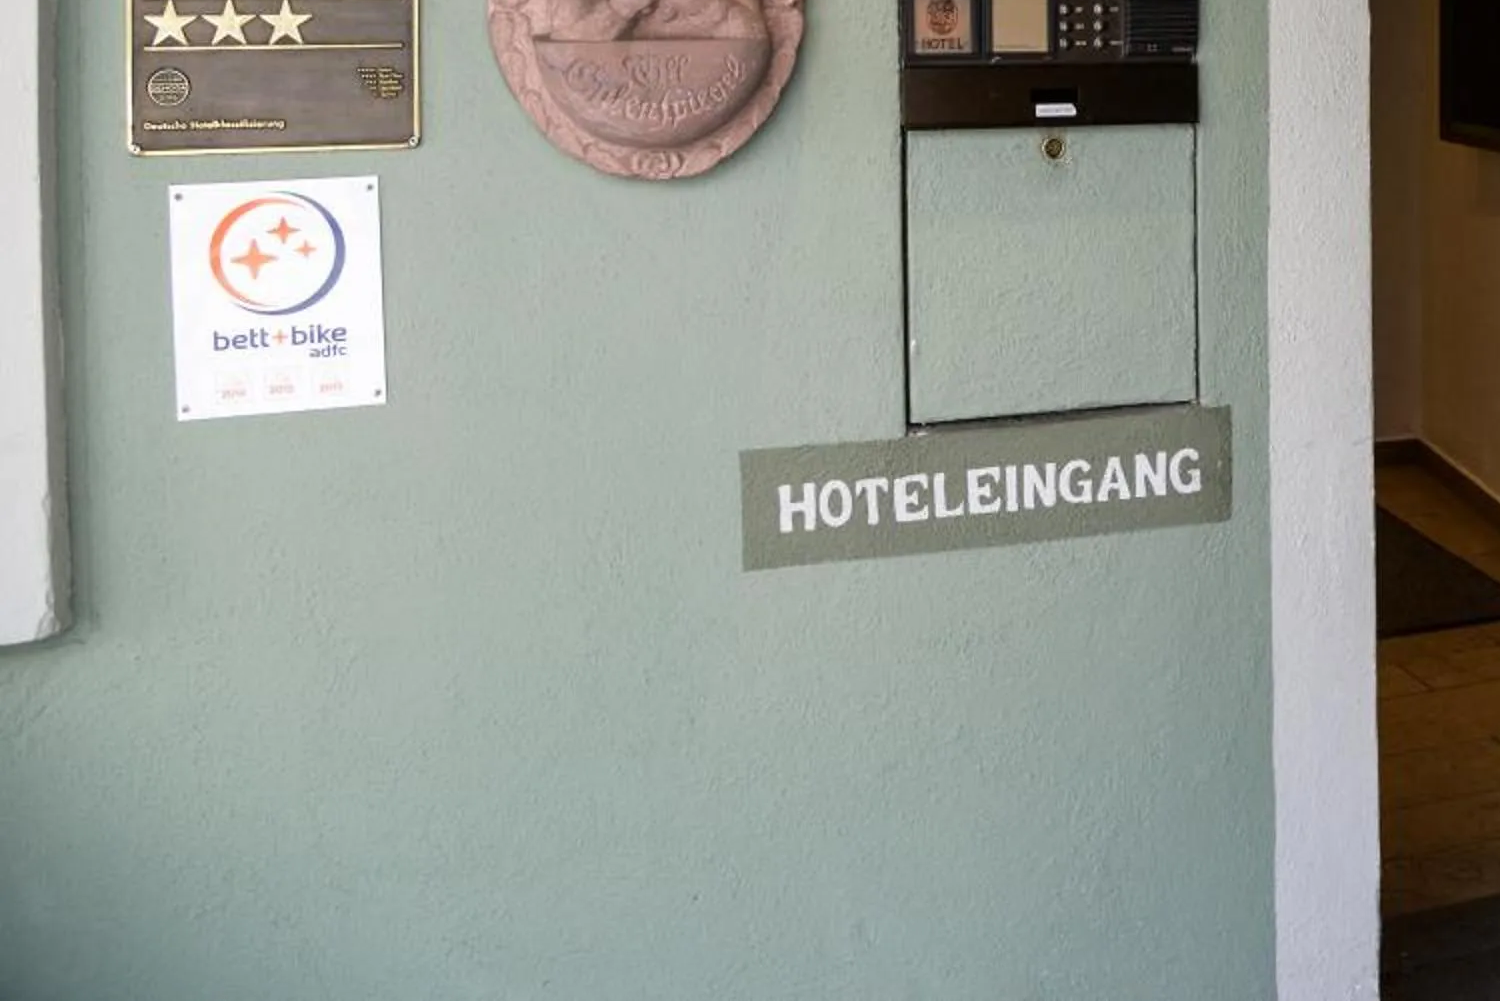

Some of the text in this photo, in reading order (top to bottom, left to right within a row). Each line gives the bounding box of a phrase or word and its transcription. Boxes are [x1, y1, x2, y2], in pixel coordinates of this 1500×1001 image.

[921, 37, 965, 50] HOTEL
[308, 345, 348, 359] adfc
[777, 447, 1202, 534] HOTELEINGANG
